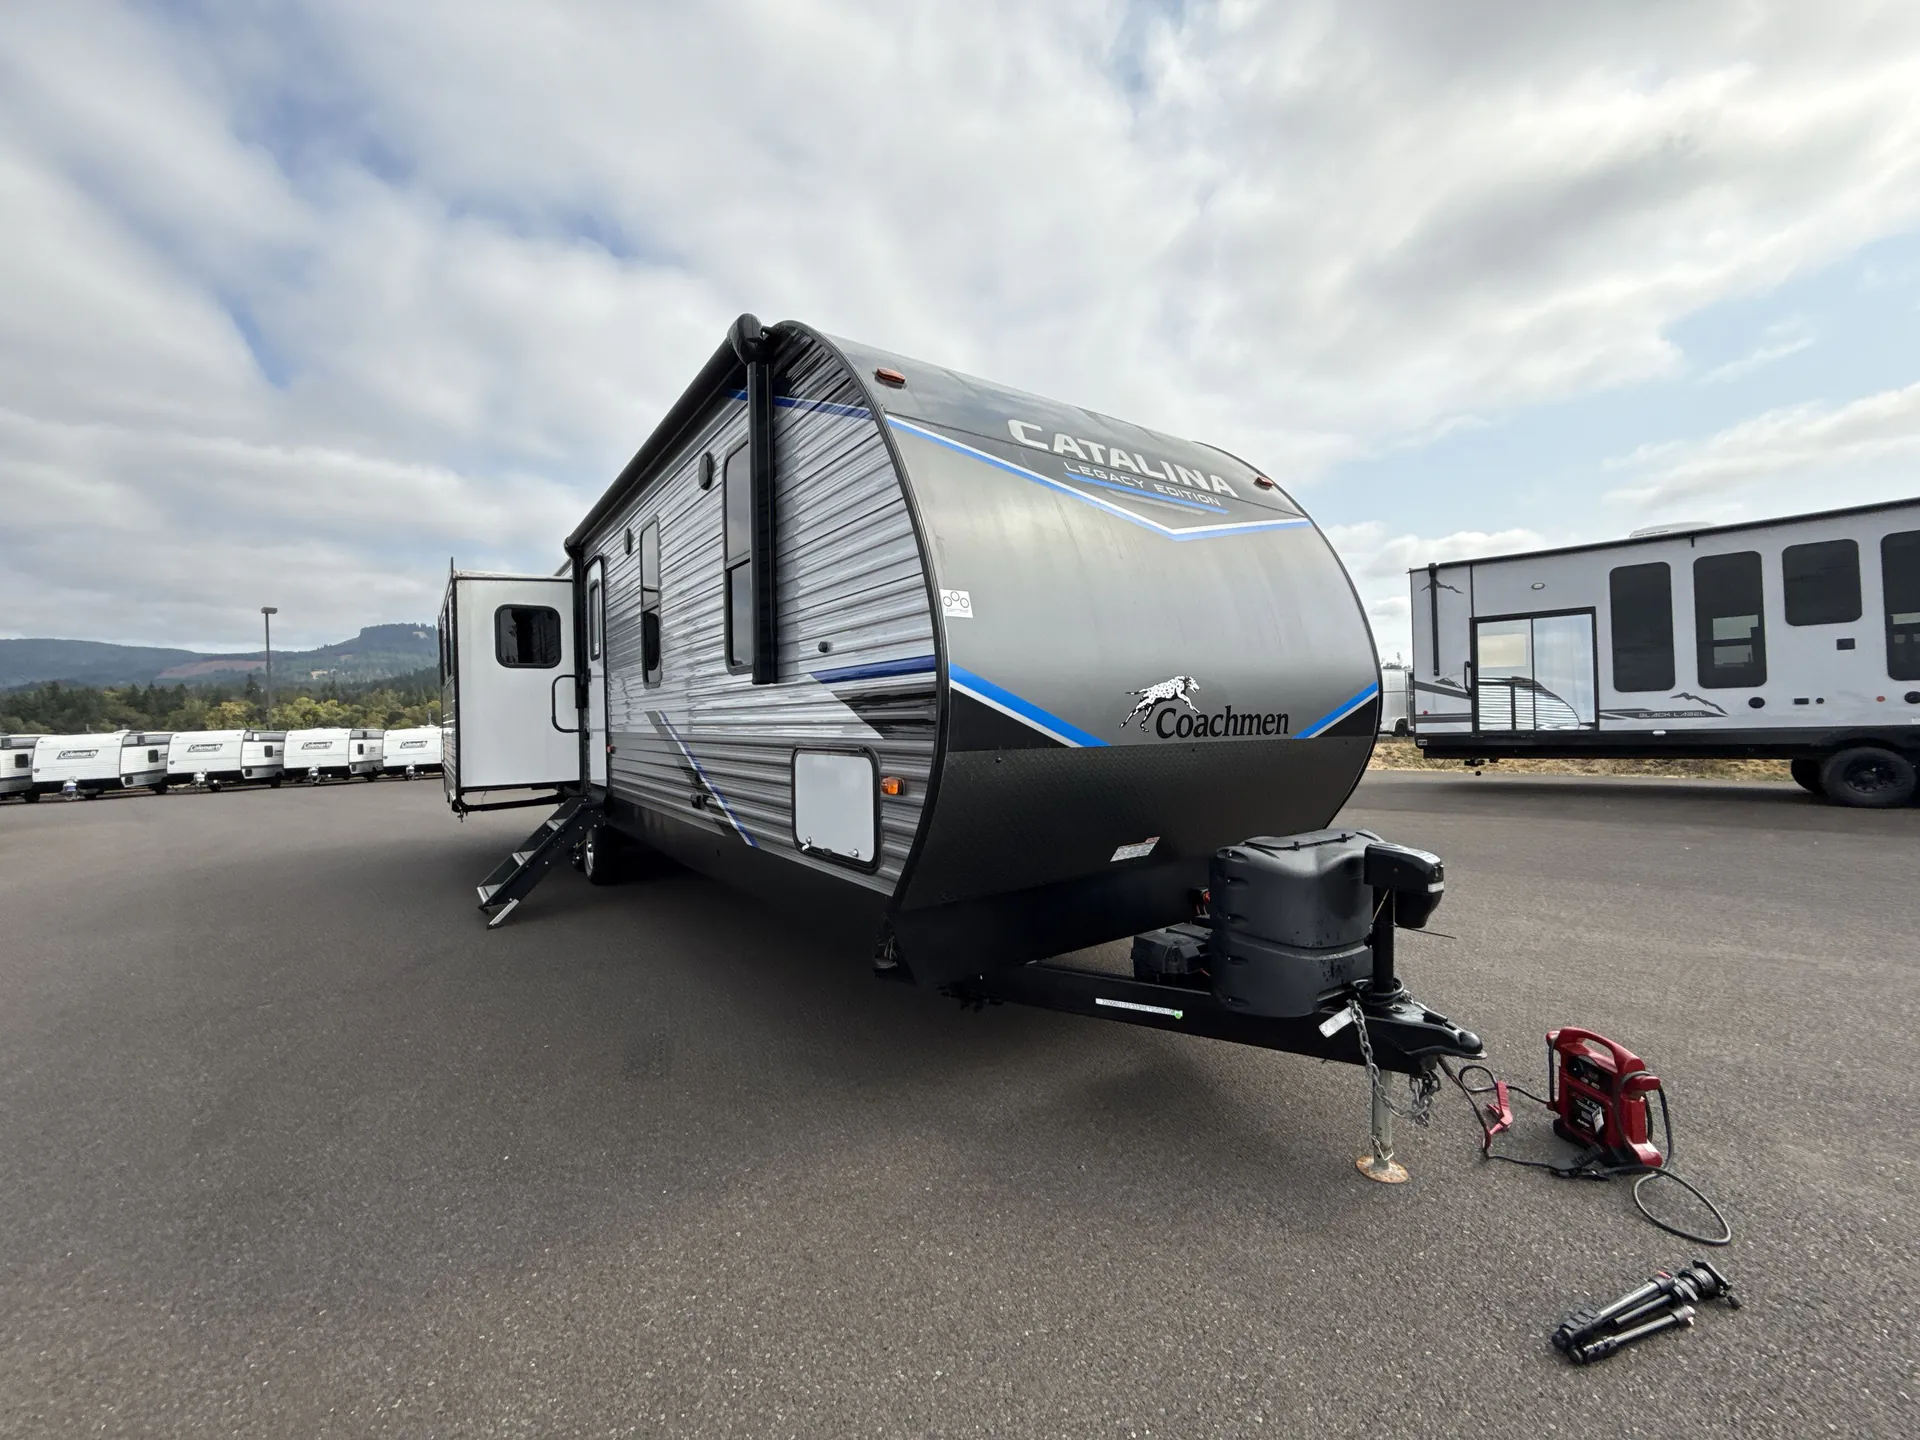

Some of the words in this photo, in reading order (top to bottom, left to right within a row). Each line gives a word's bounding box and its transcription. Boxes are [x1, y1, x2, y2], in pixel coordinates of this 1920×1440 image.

[1007, 419, 1239, 498] CATALINA
[1064, 461, 1144, 488] LEGACY
[1154, 483, 1222, 507] EDITION
[1156, 705, 1289, 739] Coachmen
[60, 750, 90, 758] Coleman
